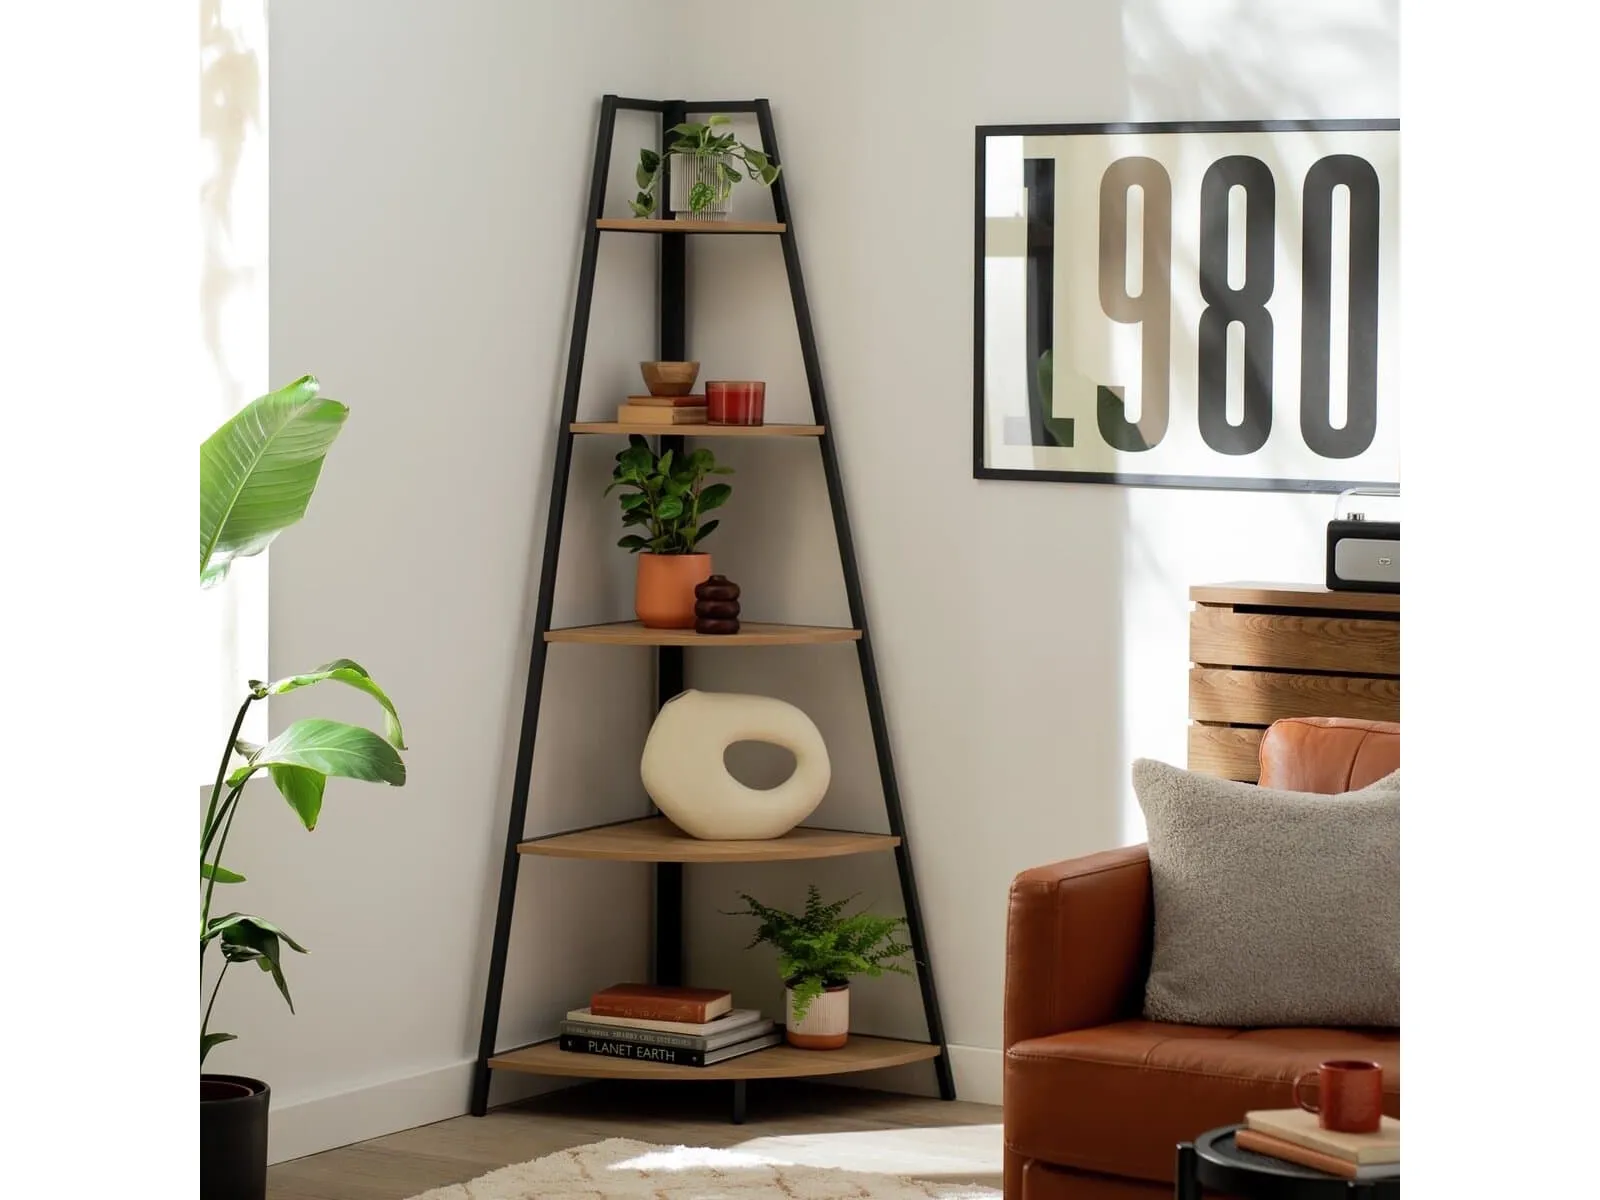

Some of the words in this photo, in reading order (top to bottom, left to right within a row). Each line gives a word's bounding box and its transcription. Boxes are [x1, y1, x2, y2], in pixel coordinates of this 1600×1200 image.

[1003, 154, 1380, 459] 1980
[588, 1040, 633, 1057] PLANET
[636, 1046, 676, 1062] EARTH
